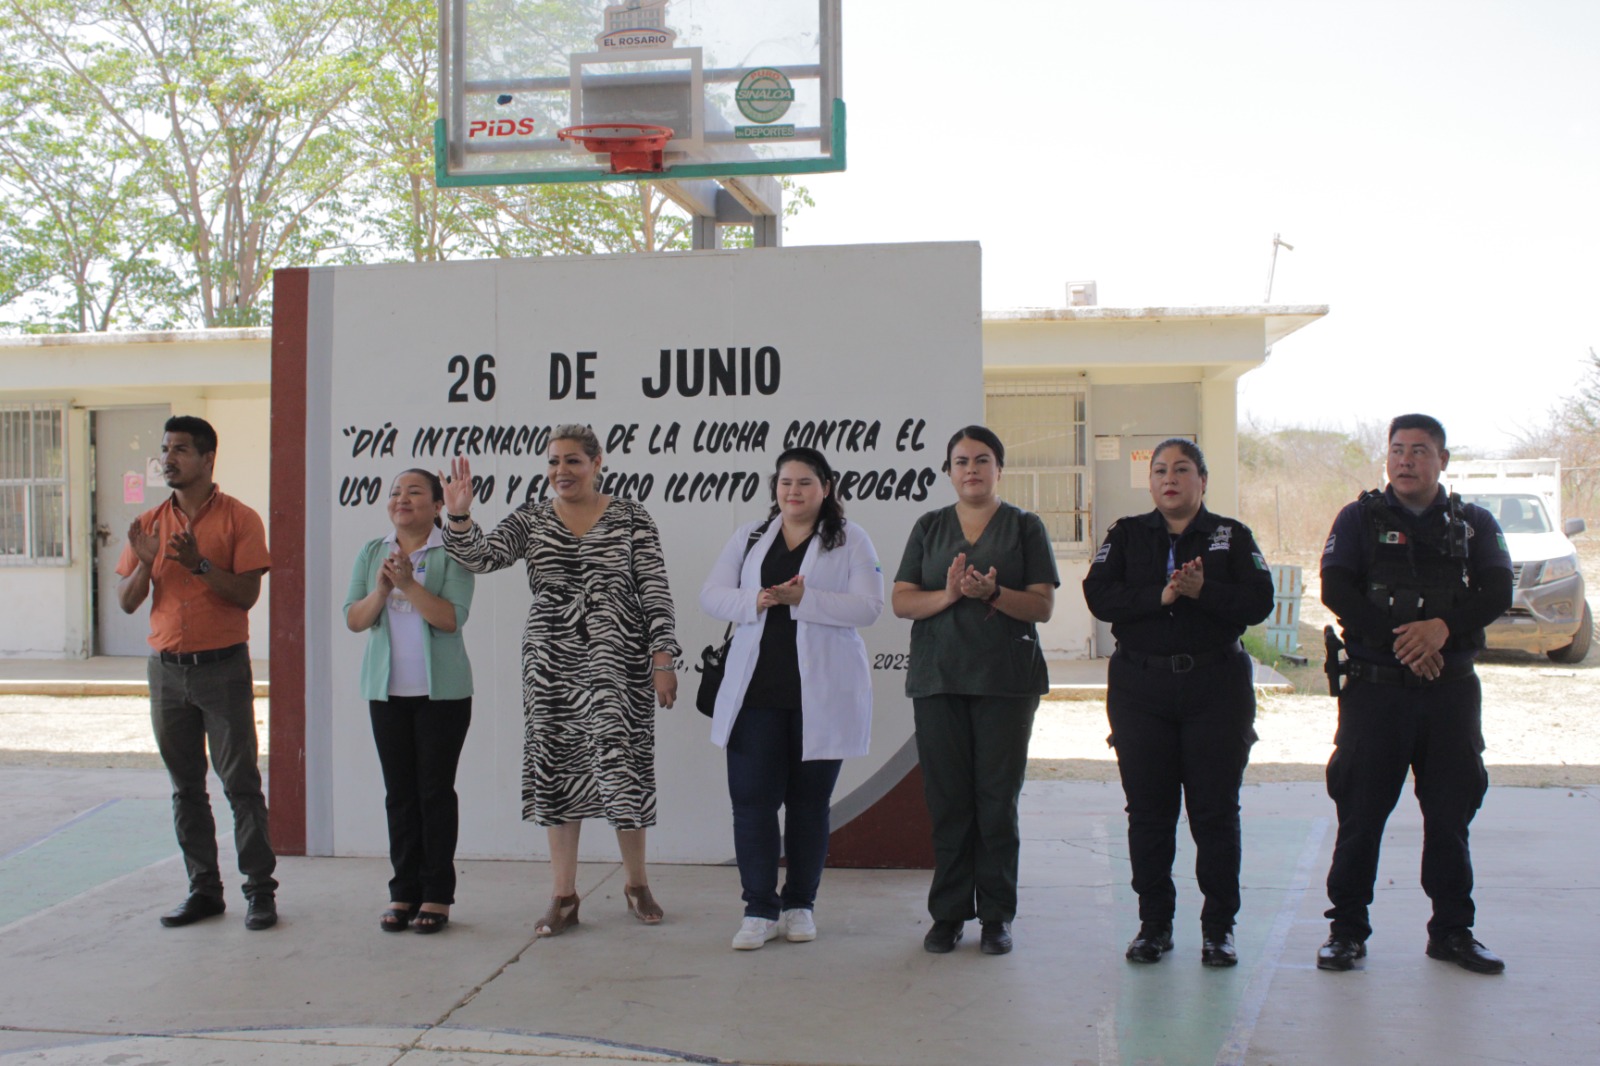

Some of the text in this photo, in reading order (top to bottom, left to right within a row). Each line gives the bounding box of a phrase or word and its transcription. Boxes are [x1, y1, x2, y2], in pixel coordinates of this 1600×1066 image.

[603, 38, 616, 47] EL
[618, 35, 667, 45] ROSARIO
[750, 70, 781, 80] PURO
[737, 89, 792, 99] SINALOA
[744, 126, 794, 137] DEPORTES
[447, 345, 781, 403] 26 DE JUNIO
[411, 423, 593, 457] INTERNACIO
[605, 423, 640, 455] DE
[648, 421, 681, 455] LA
[693, 420, 770, 454] LUCHA
[782, 419, 881, 453] CONTRA
[895, 418, 926, 452] EL
[339, 475, 382, 507] USO
[506, 474, 523, 505] Y
[663, 471, 760, 503] ILICITO
[873, 653, 911, 671] 2023
